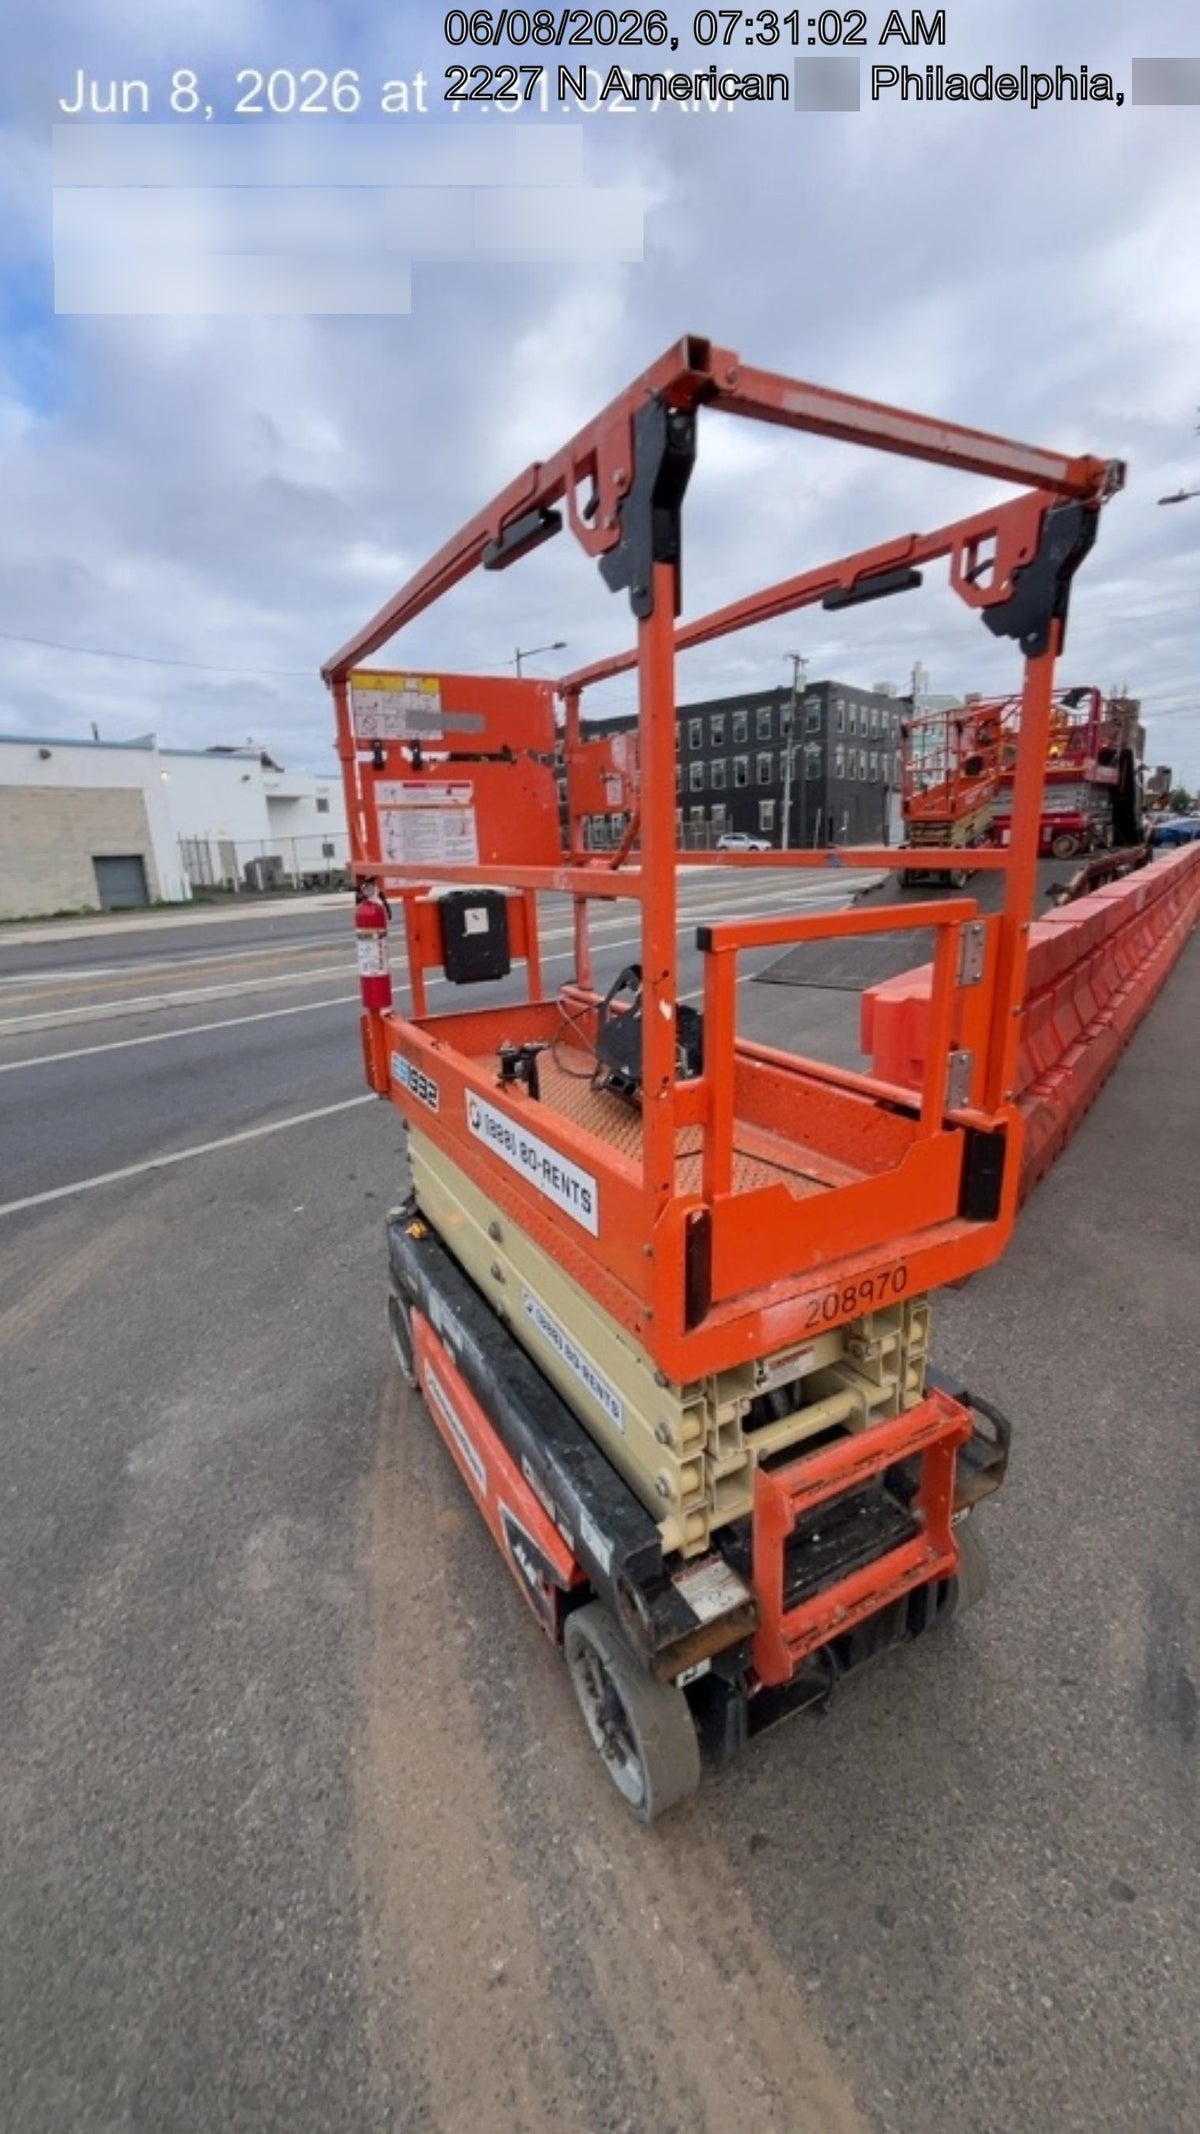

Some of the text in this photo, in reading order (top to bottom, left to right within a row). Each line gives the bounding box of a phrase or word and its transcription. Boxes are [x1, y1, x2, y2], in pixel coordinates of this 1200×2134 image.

[484, 1112, 592, 1215] (888) 80-RENTS
[804, 1265, 908, 1329] 208970
